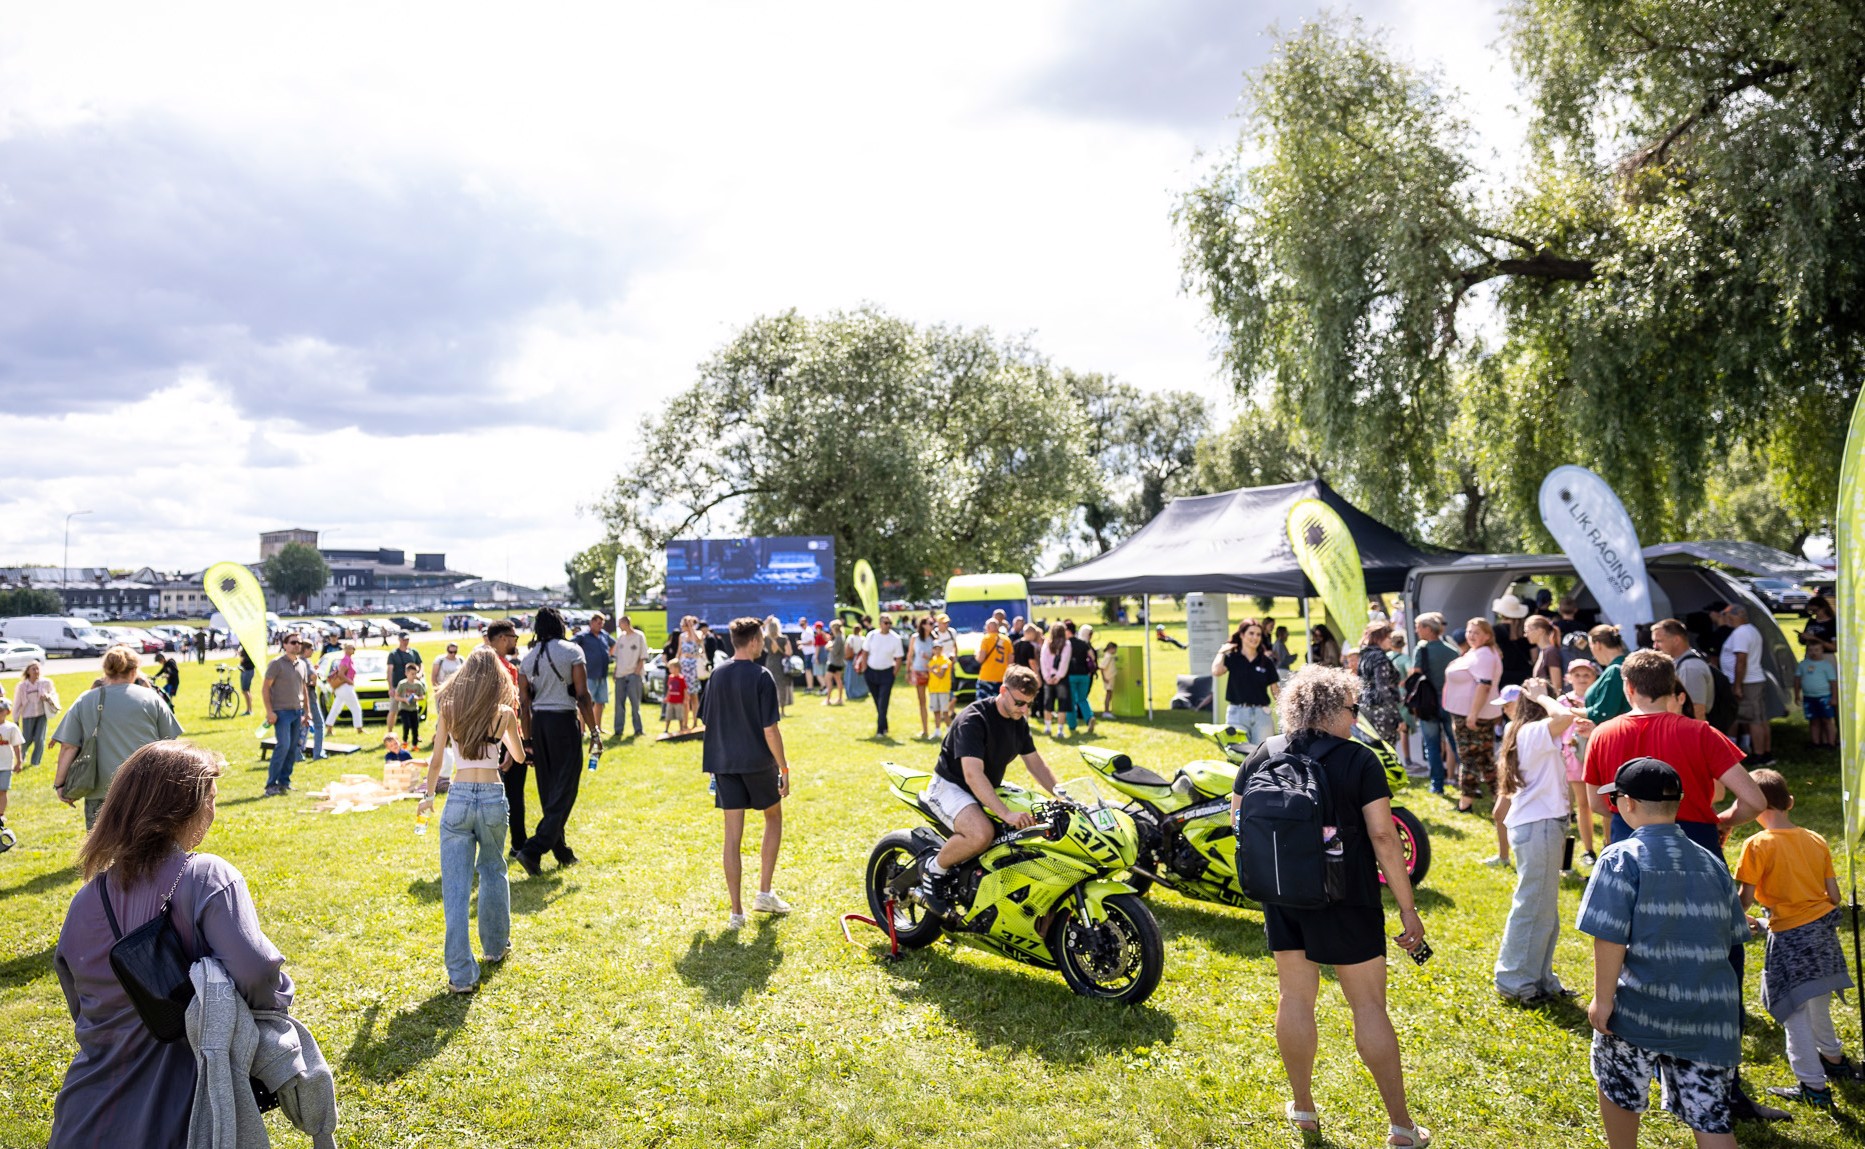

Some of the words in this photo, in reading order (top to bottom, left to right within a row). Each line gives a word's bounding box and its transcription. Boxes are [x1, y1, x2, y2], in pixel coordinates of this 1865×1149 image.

[1568, 503, 1592, 532] LIK
[1587, 528, 1635, 592] RACING
[1073, 824, 1121, 863] 377
[999, 929, 1042, 950] 377
[1002, 943, 1031, 965] LIK
